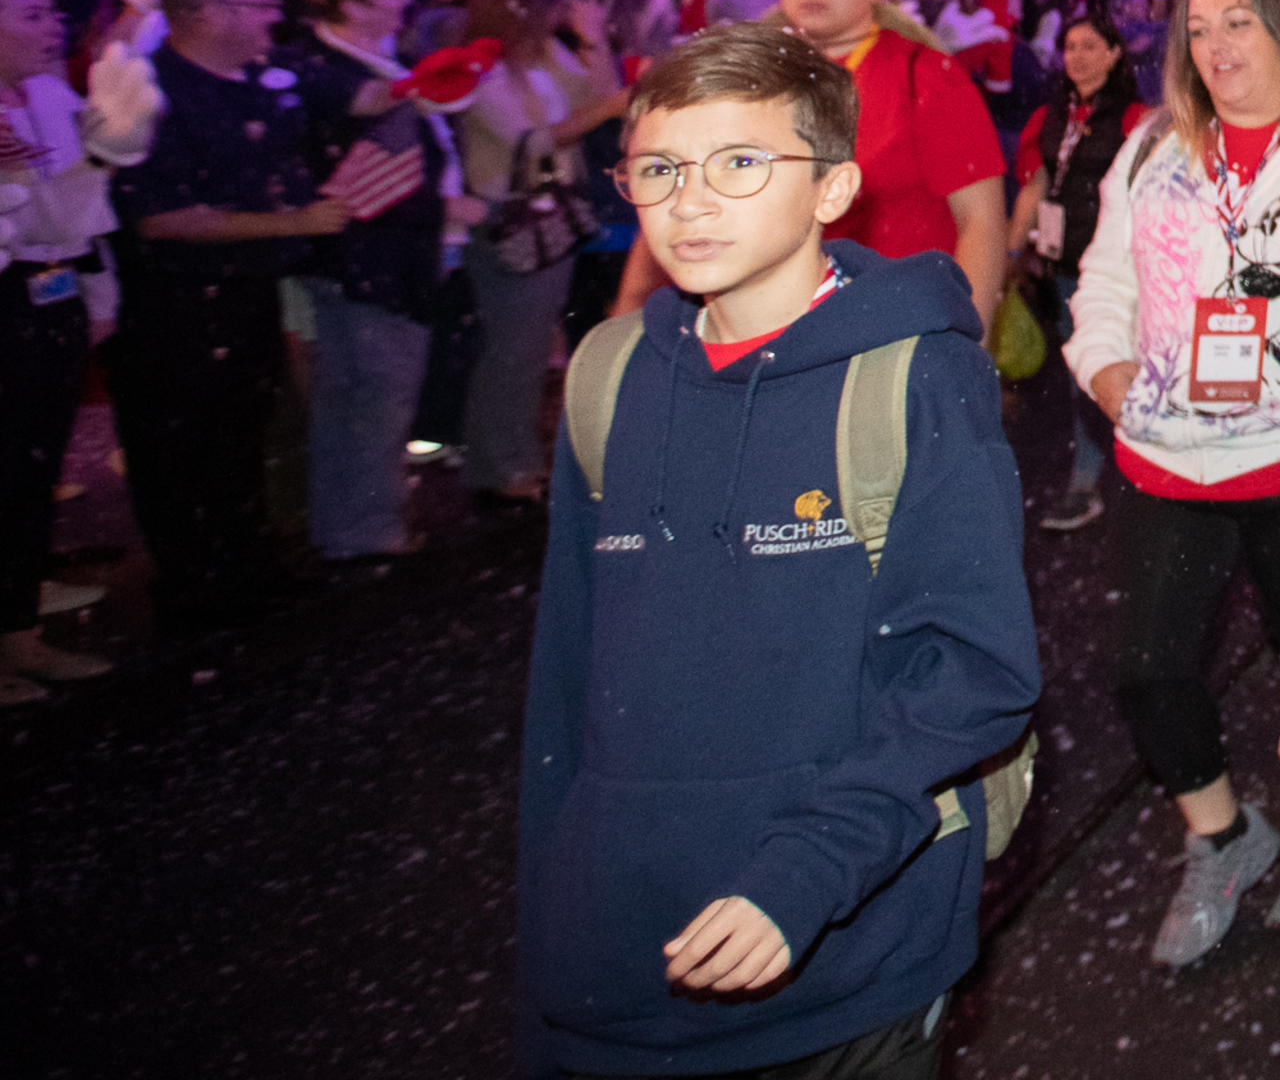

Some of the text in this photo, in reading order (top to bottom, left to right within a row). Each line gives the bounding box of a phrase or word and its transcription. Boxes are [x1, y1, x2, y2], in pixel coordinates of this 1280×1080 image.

[744, 518, 847, 542] PUSCH RID
[751, 535, 857, 555] CHRISTIAN ACADEM
